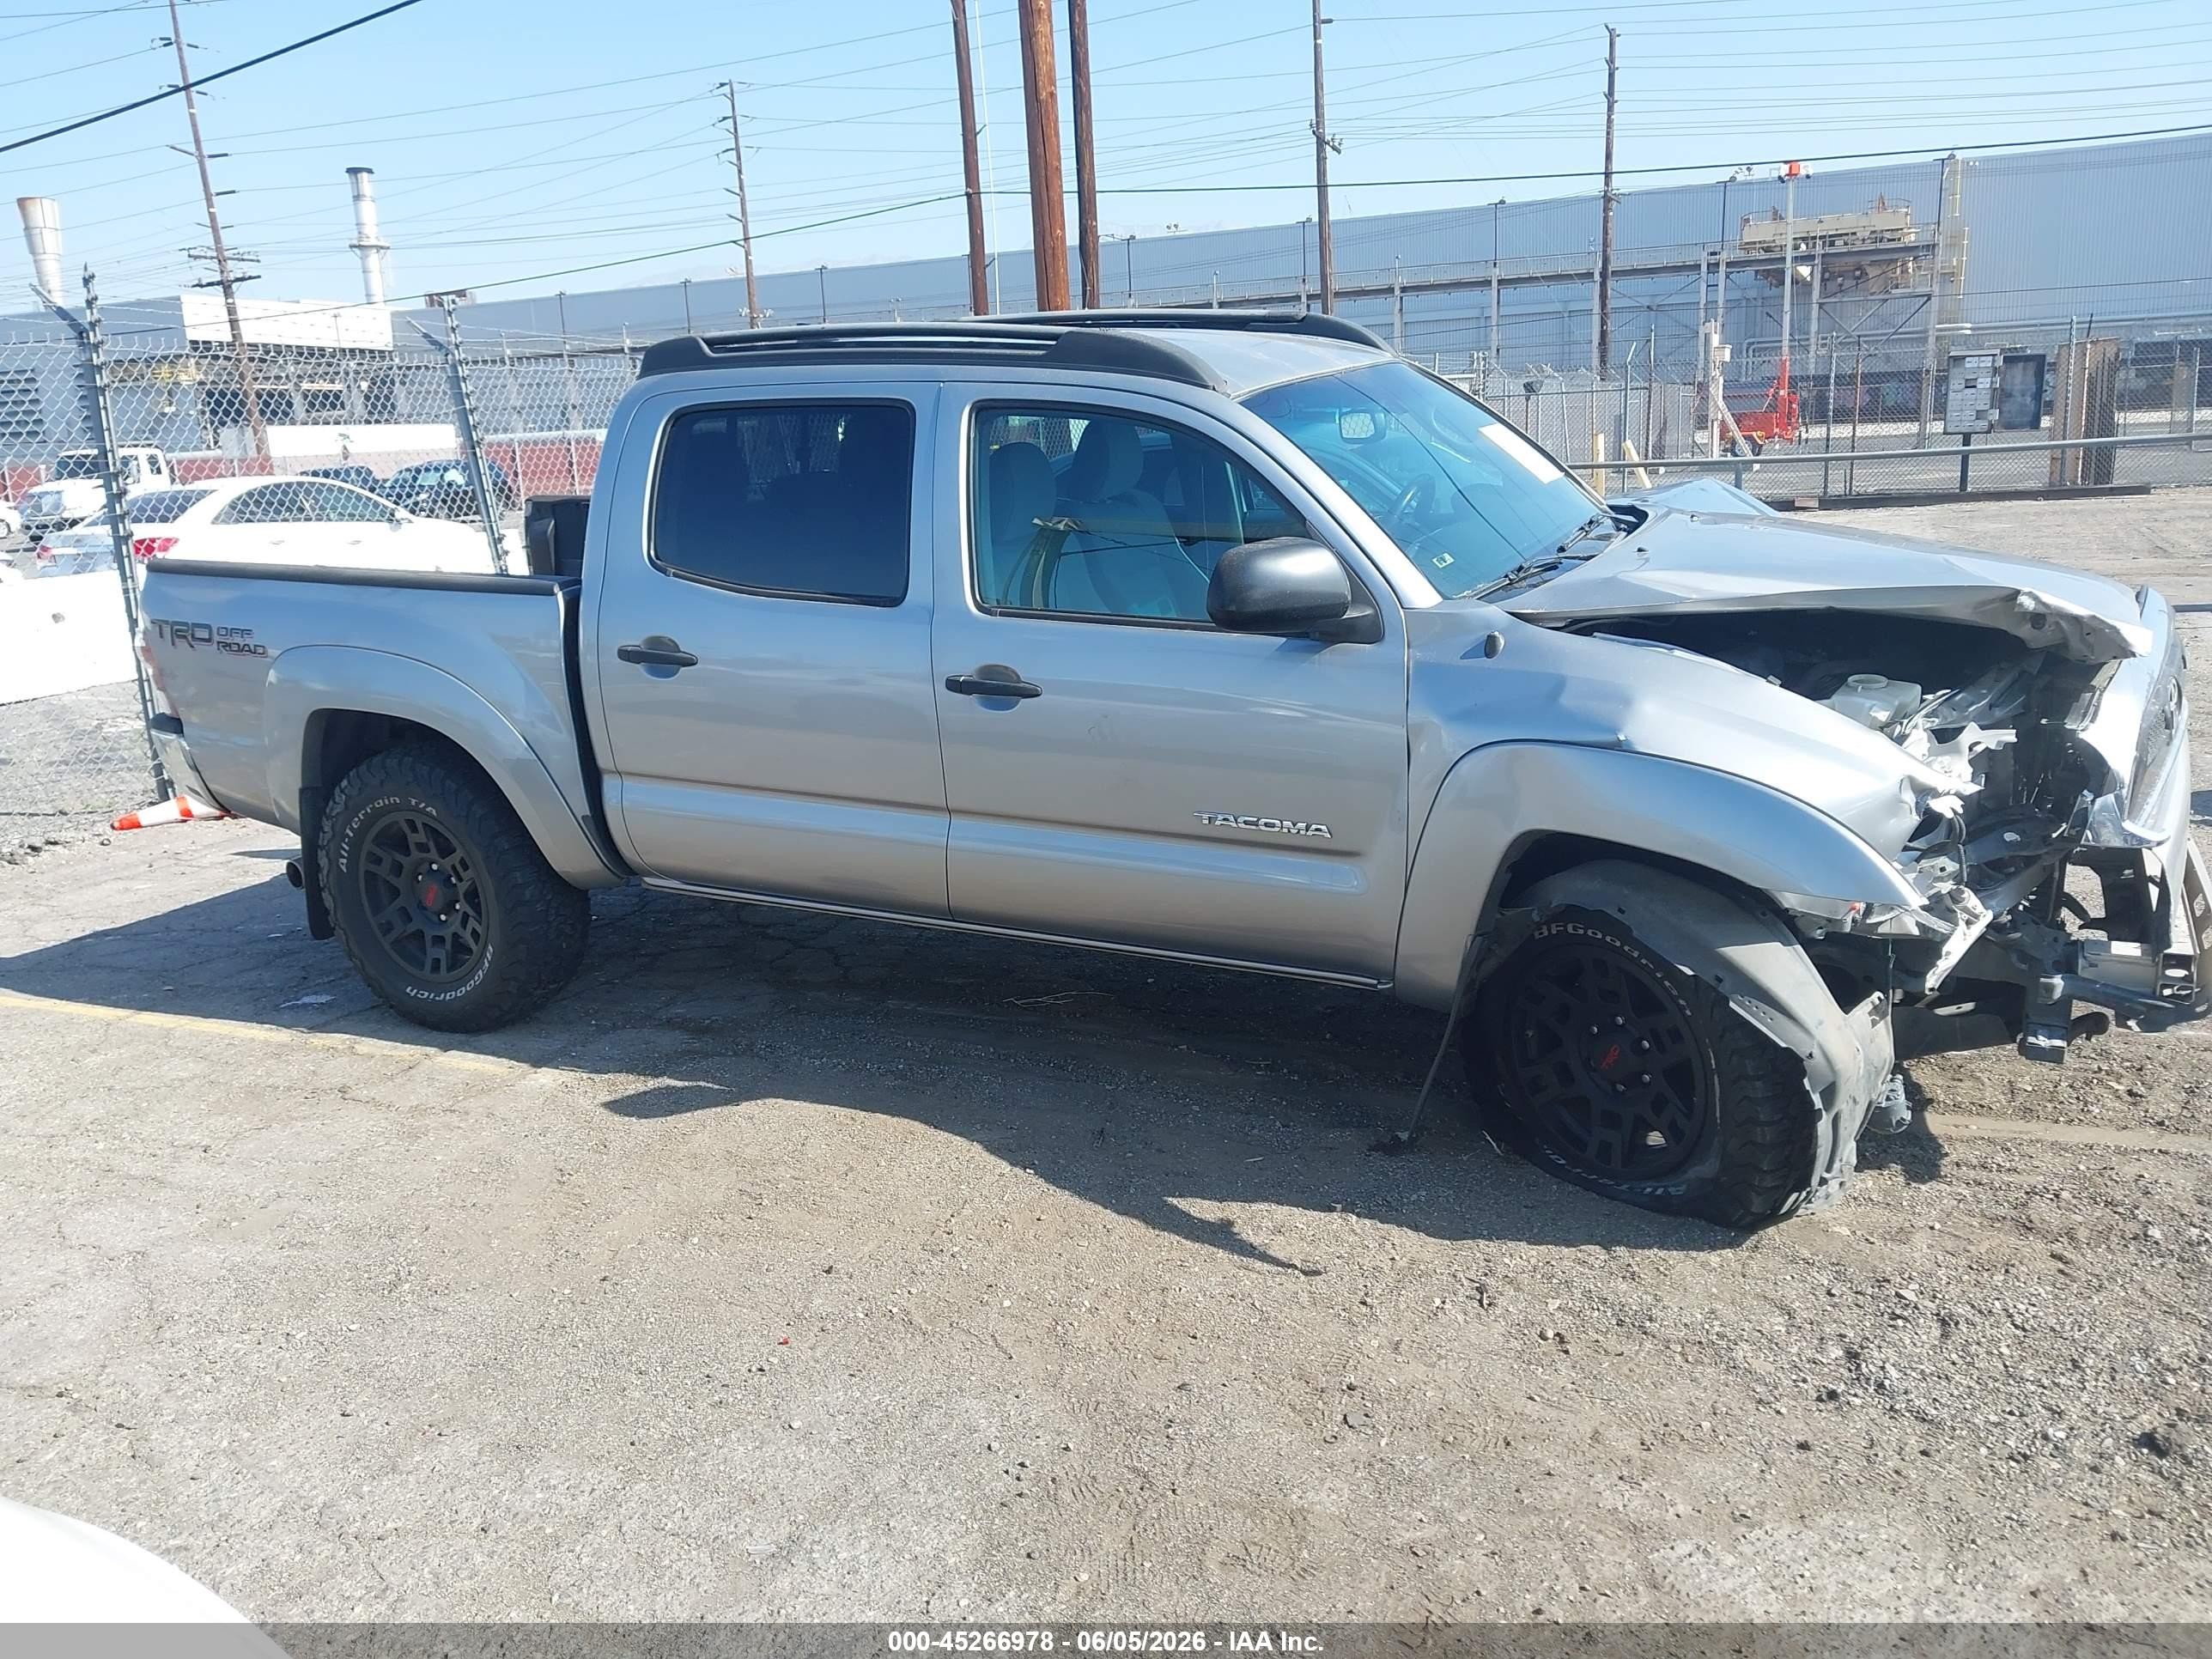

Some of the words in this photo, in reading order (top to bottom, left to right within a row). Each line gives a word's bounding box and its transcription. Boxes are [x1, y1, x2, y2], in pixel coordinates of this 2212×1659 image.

[150, 618, 213, 648] TRD
[216, 626, 253, 639] OFF
[216, 641, 267, 658] ROAD
[338, 795, 401, 873] All-Terrain
[1193, 811, 1333, 839] TACOMA
[405, 943, 494, 1002] BFGoodrich
[1534, 922, 1692, 1017] BFGoodrich
